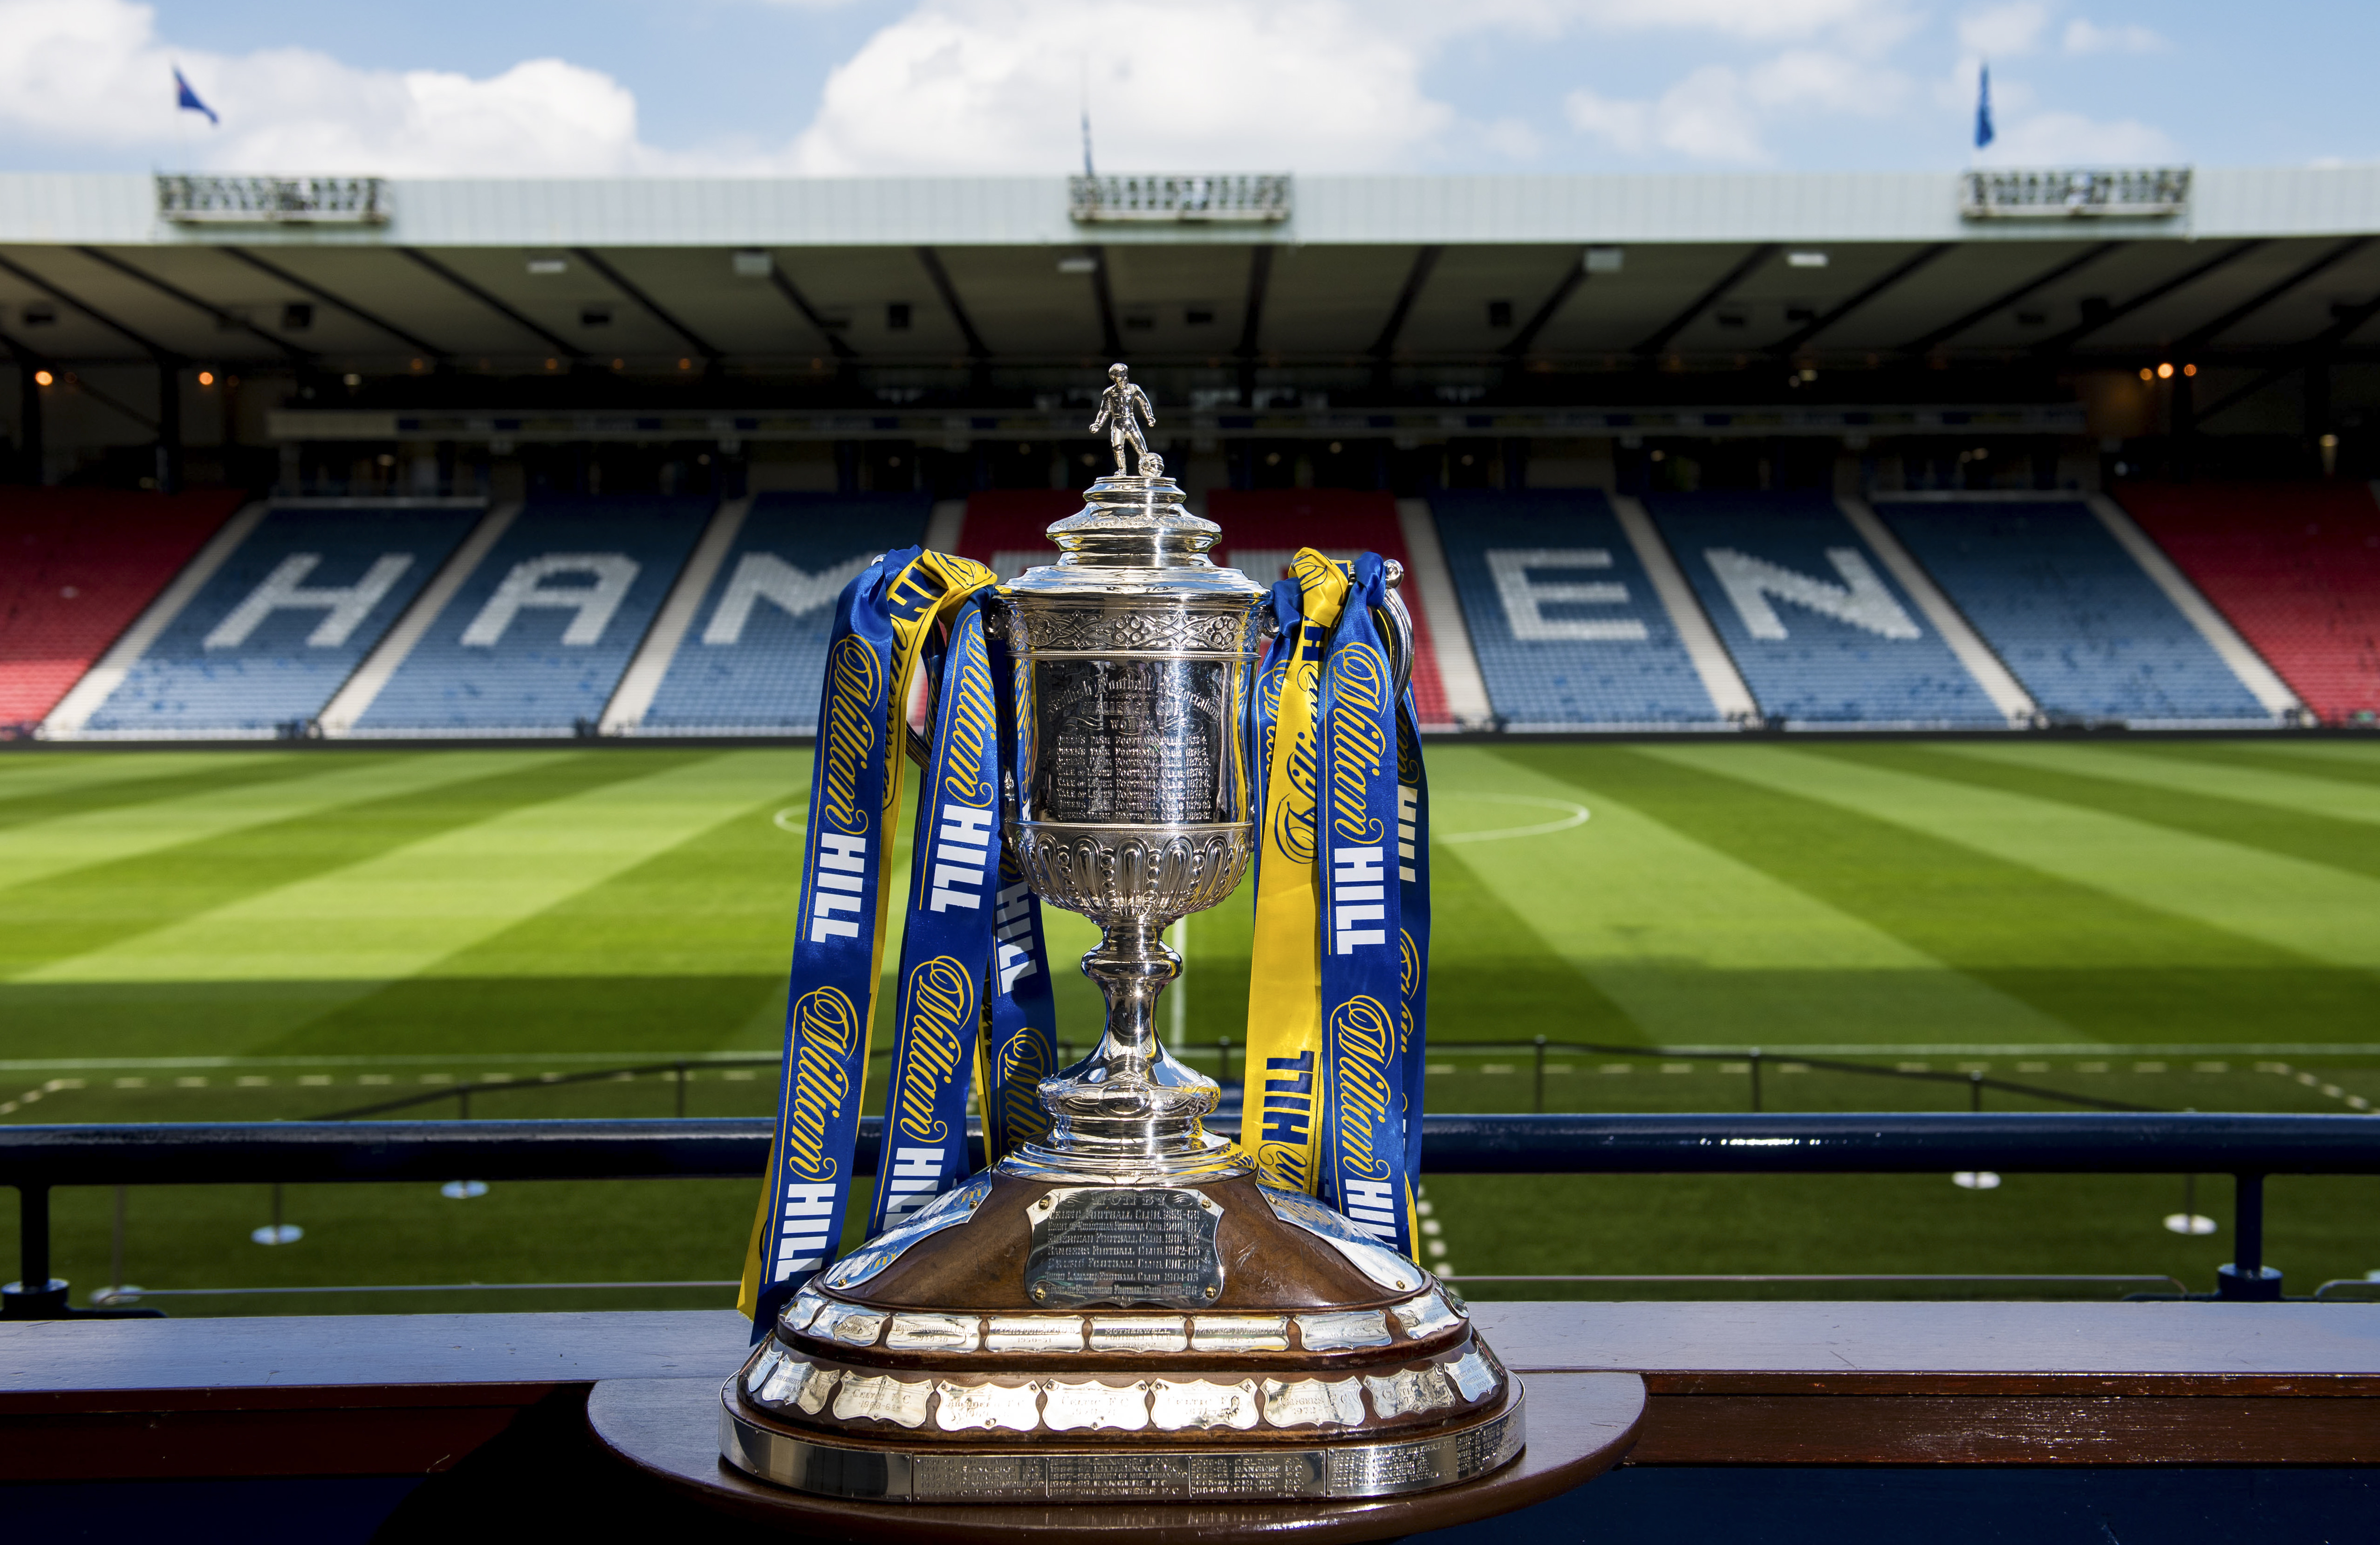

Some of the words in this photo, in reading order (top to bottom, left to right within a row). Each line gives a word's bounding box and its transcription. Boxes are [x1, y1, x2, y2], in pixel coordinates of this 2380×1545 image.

[1081, 701, 1149, 716] CHALLENGE
[826, 634, 882, 835] William
[1115, 736, 1157, 745] FOOTBALL
[1326, 642, 1388, 845] William
[1115, 747, 1157, 756] FOOTBALL
[1115, 757, 1159, 767] FOOTBALL
[1116, 768, 1158, 777] FOOTBALL
[1116, 779, 1159, 789] FOOTBALL
[1116, 790, 1158, 800] FOOTBALL
[1115, 800, 1158, 810] FOOTBALL
[1115, 811, 1159, 820] FOOTBALL
[930, 805, 993, 912] HILL
[811, 832, 866, 943] HILL
[1334, 847, 1385, 954] HILL
[997, 881, 1037, 994] HILL
[900, 955, 974, 1144] William
[789, 986, 859, 1182] William
[1330, 995, 1395, 1180] William
[1262, 1051, 1314, 1145] HILL
[1091, 1193, 1136, 1206] WON
[1142, 1193, 1168, 1206] BY
[1085, 1210, 1133, 1220] FOOTBALL
[774, 1183, 836, 1282] HILL
[1096, 1233, 1137, 1244] FOOTBALL
[1048, 1246, 1090, 1255] RANGERS
[1092, 1245, 1135, 1255] FOOTBALL
[1088, 1258, 1136, 1268] FOOTBALL
[853, 1389, 885, 1400] CELTIC
[1235, 1465, 1281, 1473] RANGERS
[1101, 1487, 1156, 1496] RANGERS
